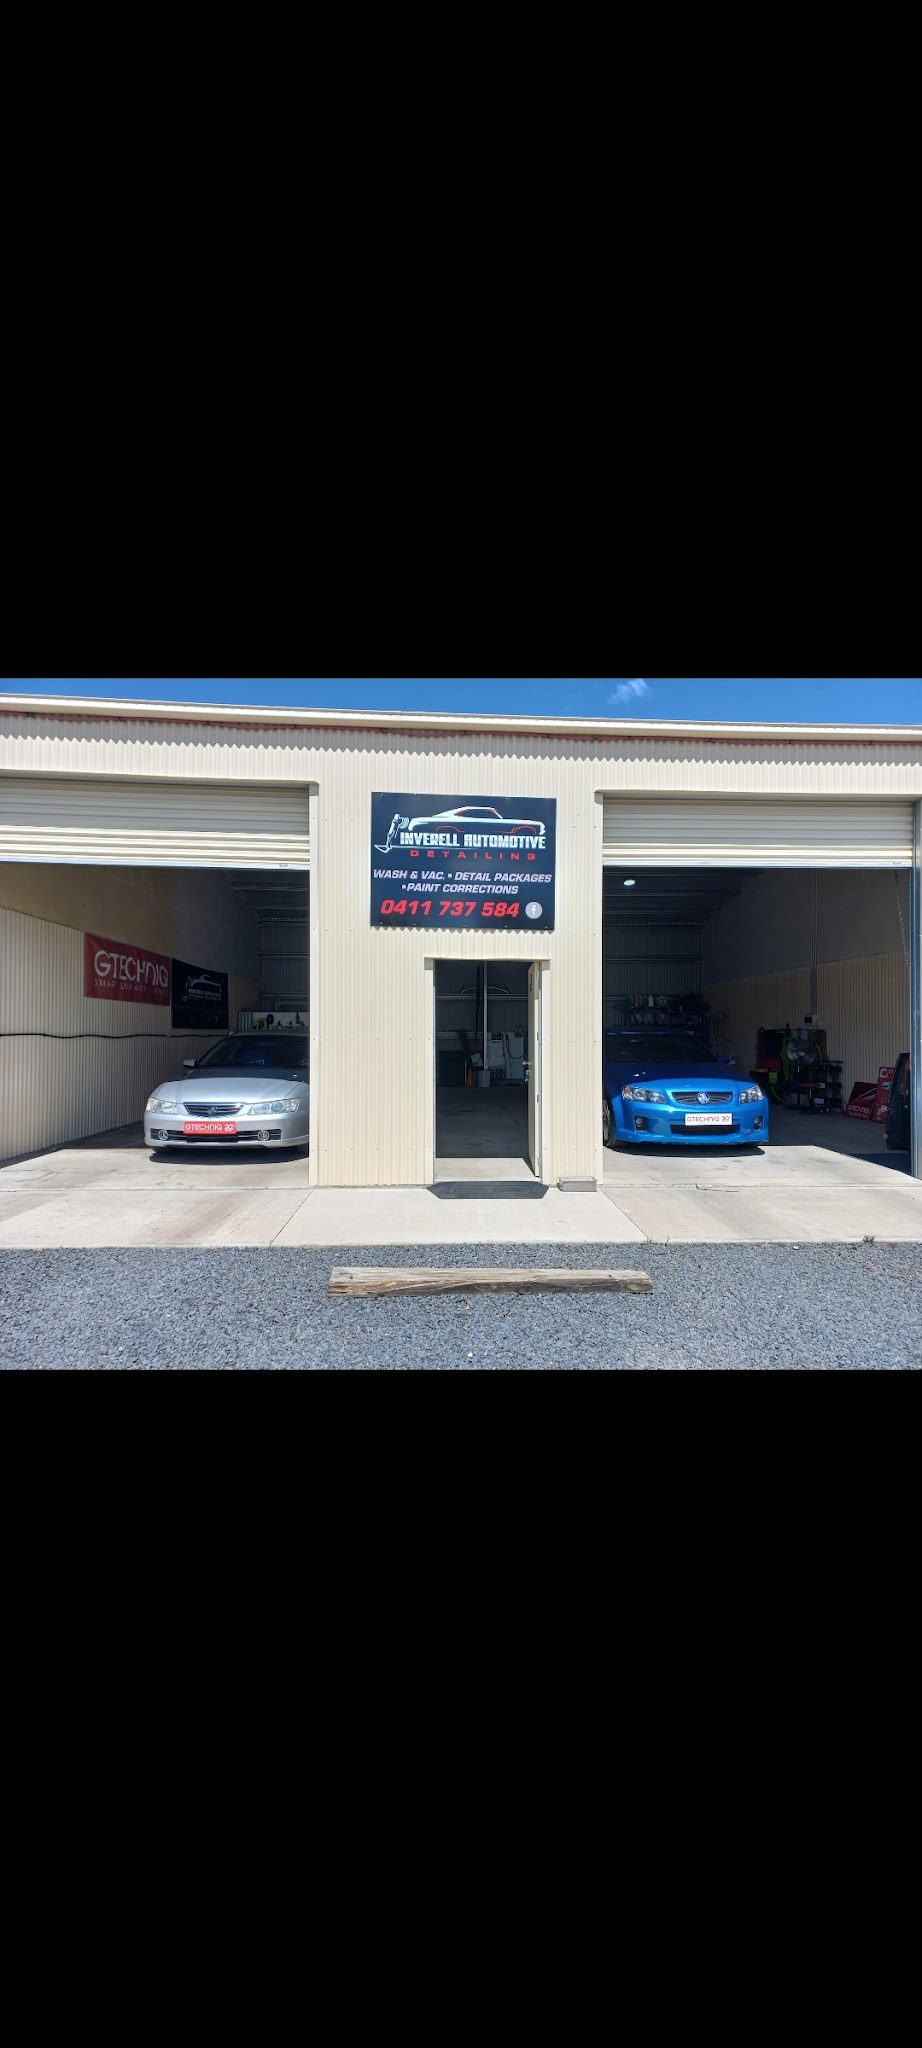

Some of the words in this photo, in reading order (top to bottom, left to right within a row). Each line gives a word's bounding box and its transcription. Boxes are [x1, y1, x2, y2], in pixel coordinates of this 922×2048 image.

[400, 832, 460, 847] INVERELL
[464, 834, 546, 849] AUTOMOTIVE
[410, 850, 536, 861] DETAILING
[373, 869, 407, 879] WASH
[410, 871, 418, 879] &
[422, 871, 445, 880] VAC.
[454, 872, 492, 882] DETAIL
[494, 873, 552, 883] PACKAGES
[443, 884, 519, 894] CORRECTIONS
[380, 899, 433, 915] 0411
[439, 900, 477, 916] 737
[481, 902, 520, 917] 584
[94, 949, 169, 988] GTECHNIQ
[185, 1123, 223, 1131] GTECHNIQ
